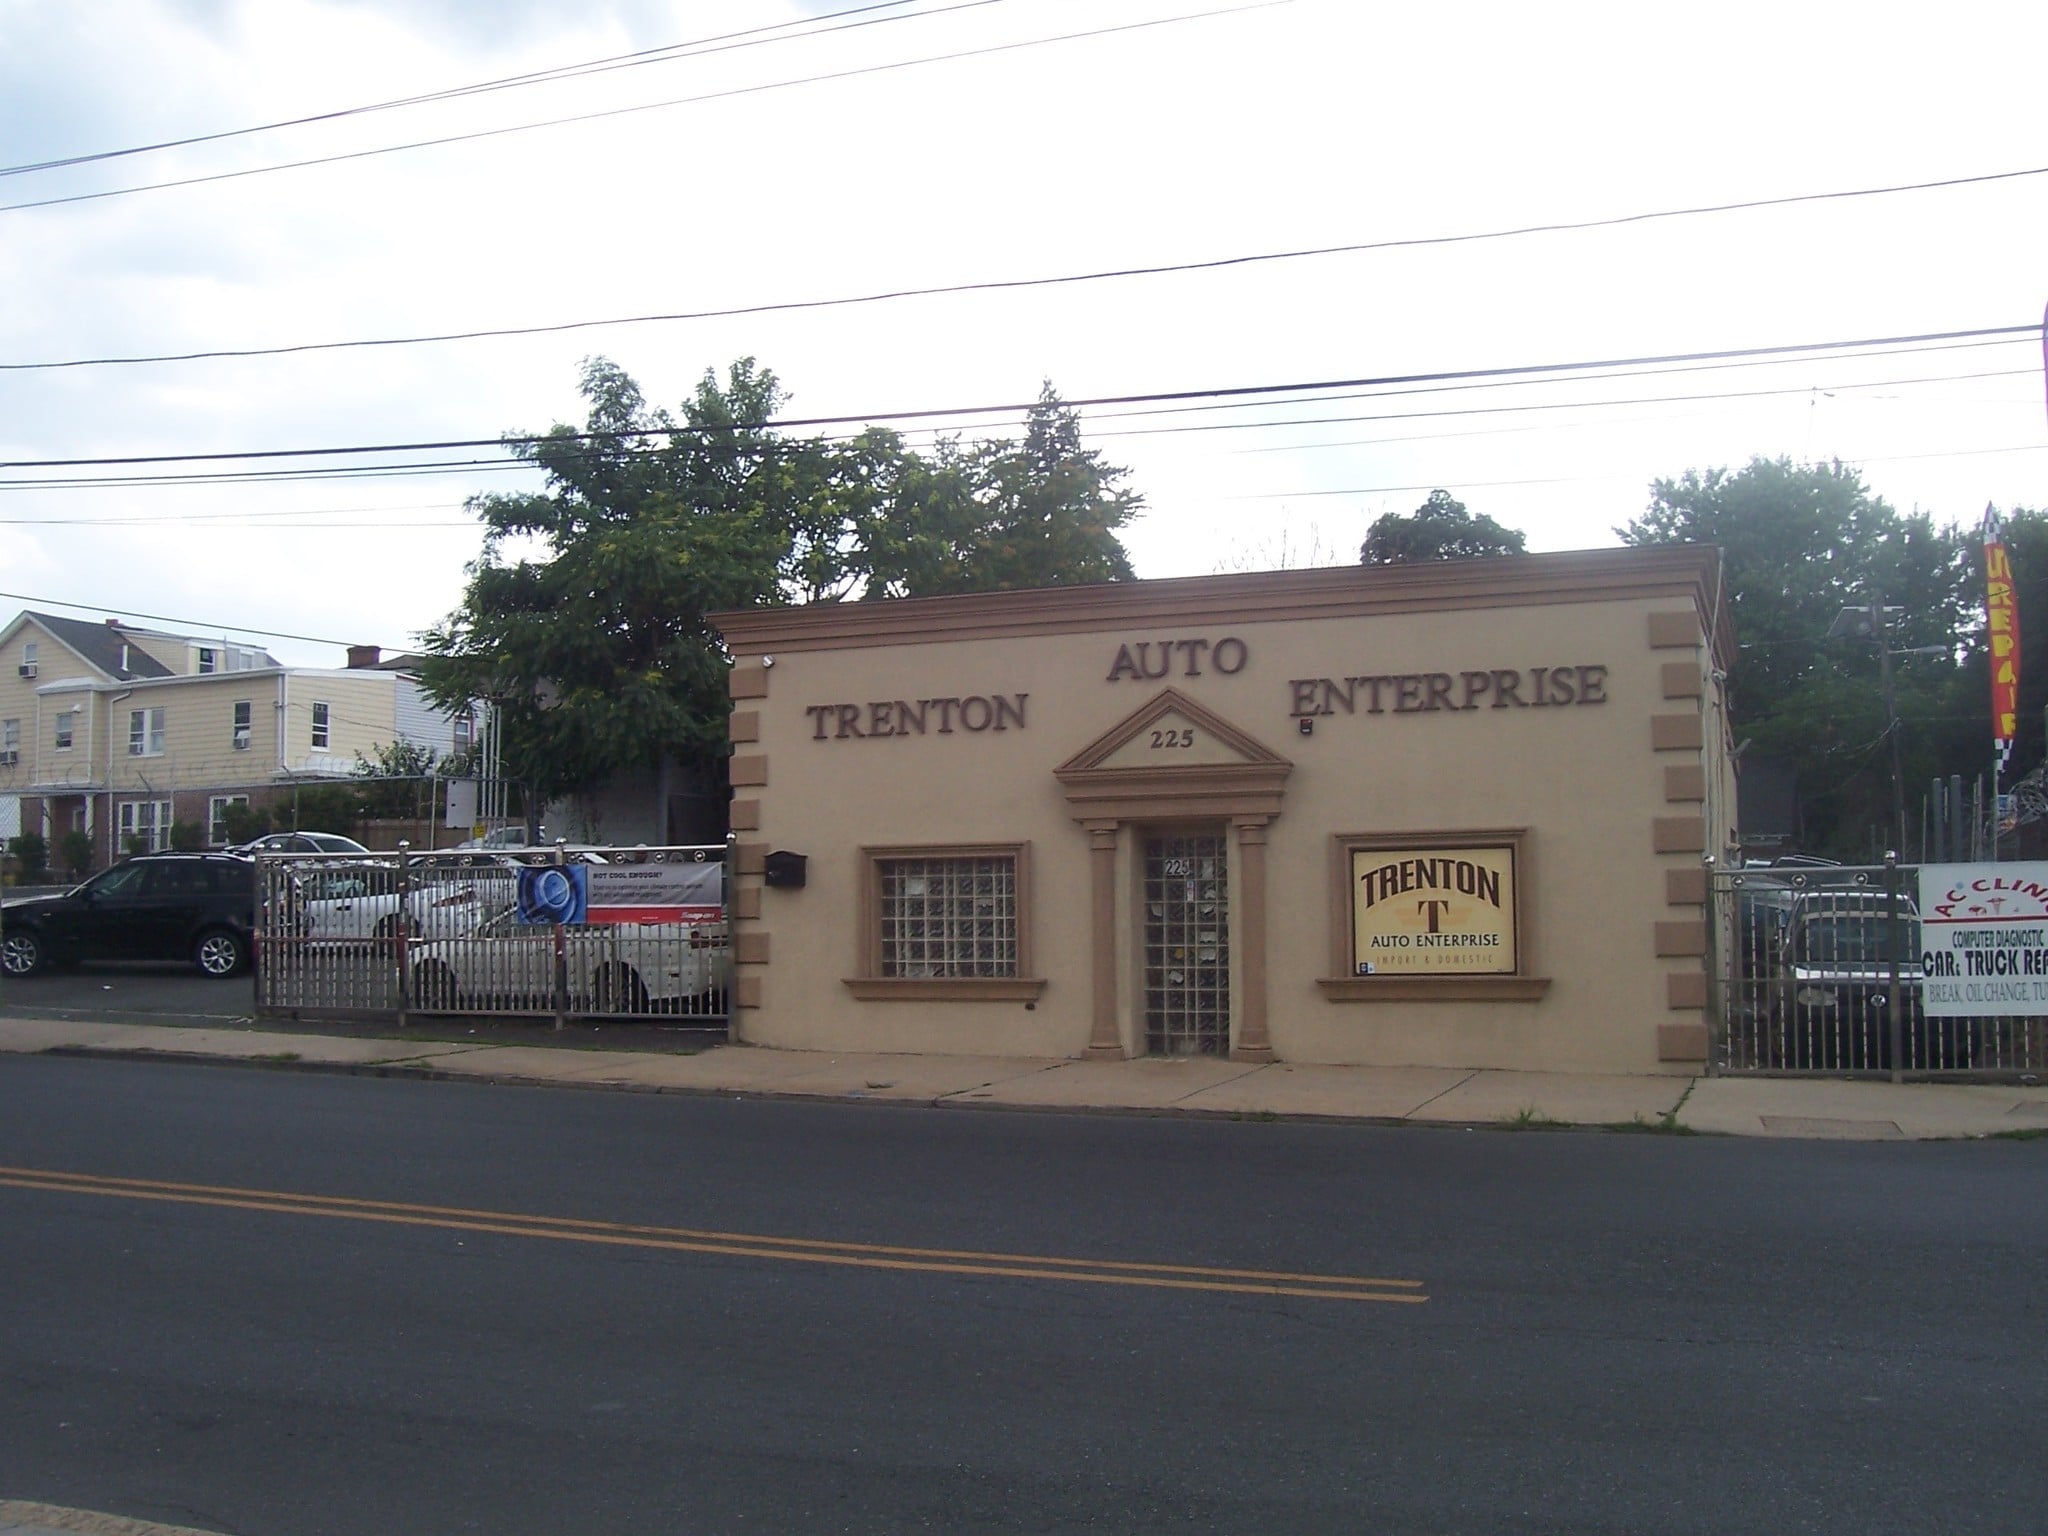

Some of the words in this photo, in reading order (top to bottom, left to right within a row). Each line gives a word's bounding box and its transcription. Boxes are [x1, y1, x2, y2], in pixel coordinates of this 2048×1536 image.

[806, 693, 1029, 740] TRENTON
[1107, 637, 1248, 681] AUTO
[1288, 664, 1608, 717] ENTERPRISE
[1151, 729, 1193, 749] 225
[609, 871, 628, 879] COOL
[1165, 860, 1189, 875] 225
[1361, 858, 1500, 909] TRENTON
[1418, 900, 1449, 934] T
[1371, 935, 1410, 948] AUTO
[1416, 934, 1499, 948] ENTERPRISE
[1952, 930, 1994, 949] COMPUTER
[1996, 929, 2044, 948] DIAGNOSTIC
[1376, 955, 1416, 966] IMPORT
[1438, 954, 1493, 965] DOMESTIC
[1965, 949, 2018, 976] TRUCK
[1966, 984, 1981, 1002] OIL
